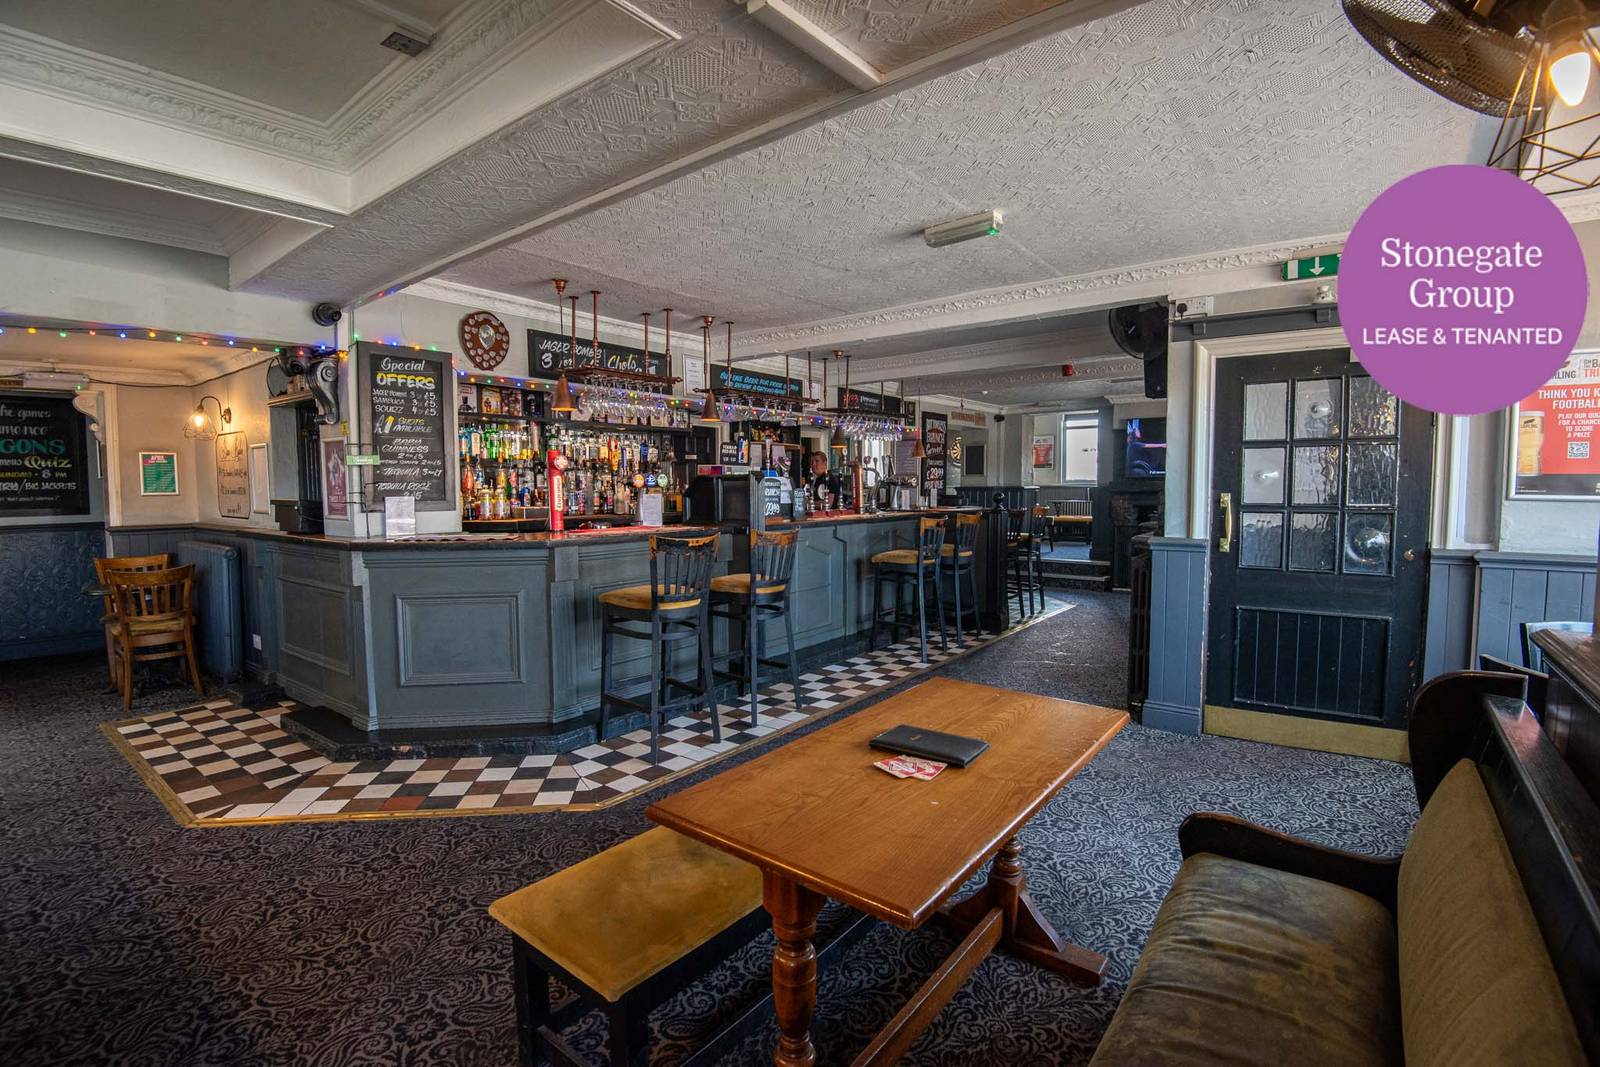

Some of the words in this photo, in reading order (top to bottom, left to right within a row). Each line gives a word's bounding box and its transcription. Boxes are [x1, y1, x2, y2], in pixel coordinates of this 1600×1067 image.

[381, 357, 425, 372] Special
[541, 353, 553, 368] 3
[376, 372, 435, 389] OFFERS
[1538, 388, 1568, 400] THINK
[1571, 387, 1591, 399] YOU
[1558, 412, 1573, 420] PLAY
[381, 445, 430, 454] GUINNESS
[23, 455, 73, 470] Quiz
